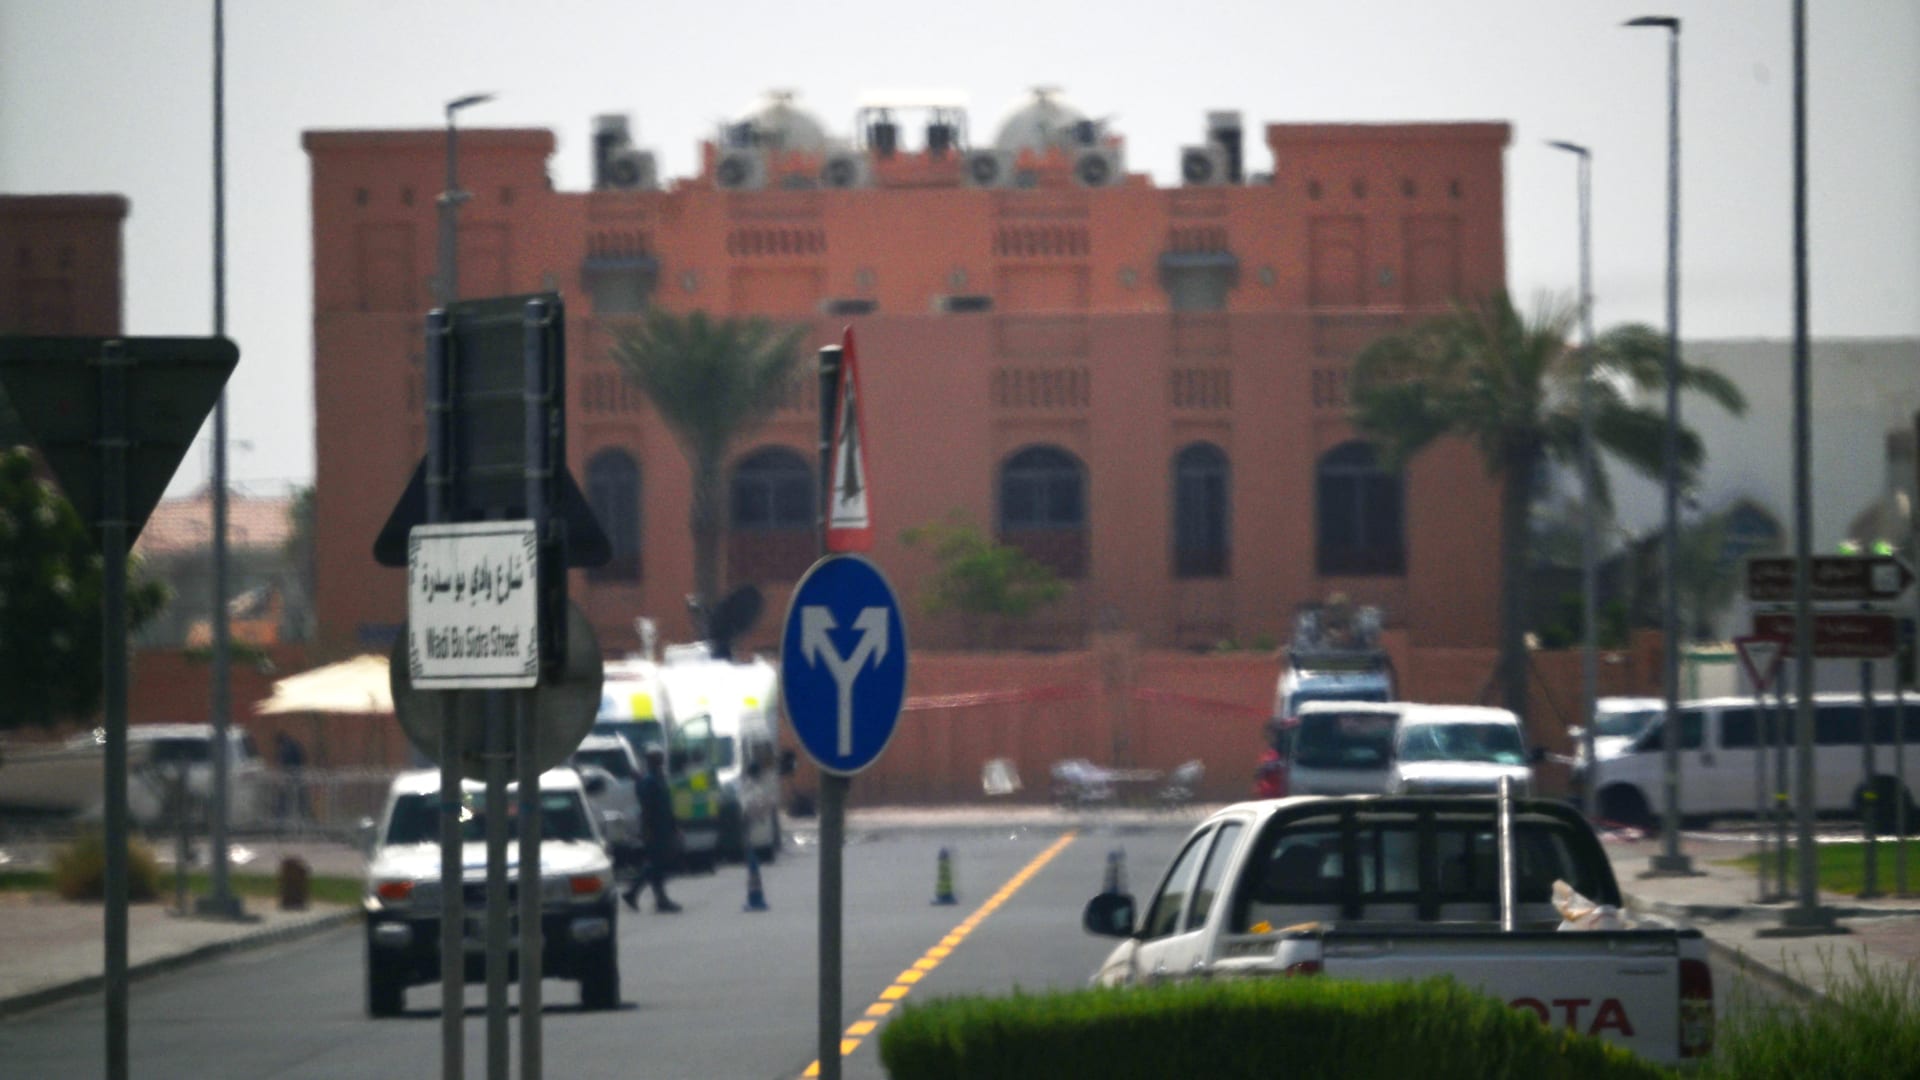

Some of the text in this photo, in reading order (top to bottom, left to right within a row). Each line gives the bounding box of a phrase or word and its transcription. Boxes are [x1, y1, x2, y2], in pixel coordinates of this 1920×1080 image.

[470, 554, 492, 607] وادي
[497, 554, 523, 604] شارع
[426, 625, 519, 659] Wadi Bu Sidra Street
